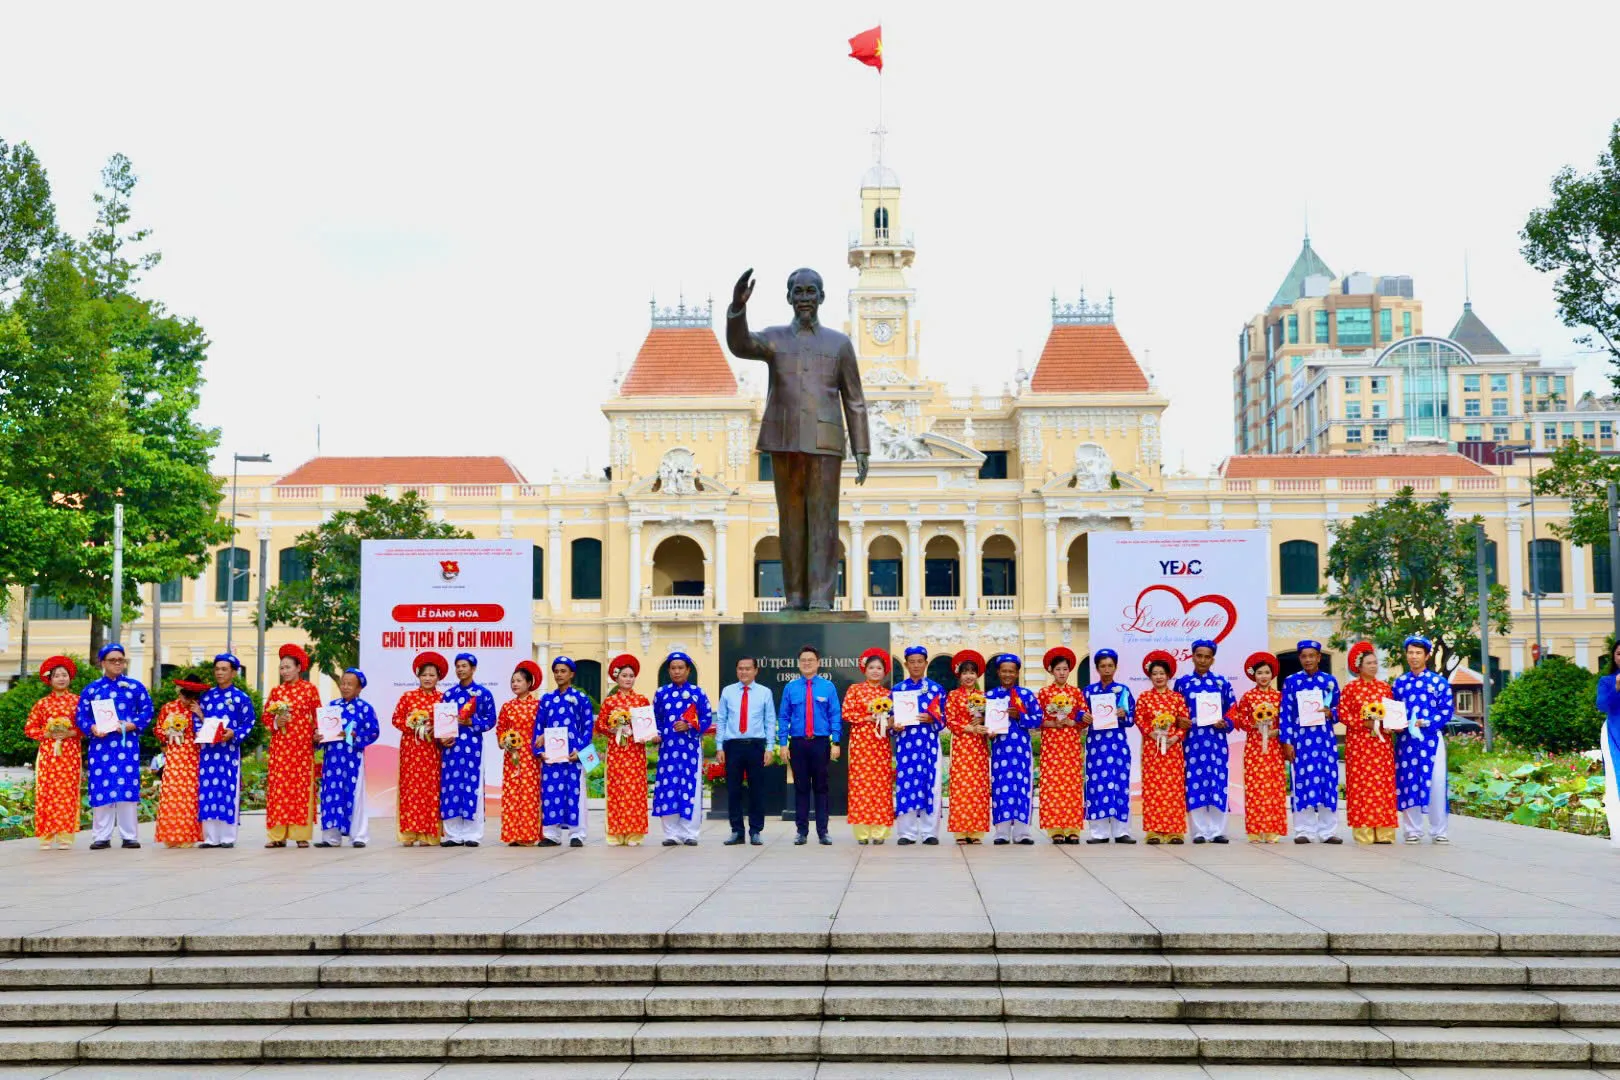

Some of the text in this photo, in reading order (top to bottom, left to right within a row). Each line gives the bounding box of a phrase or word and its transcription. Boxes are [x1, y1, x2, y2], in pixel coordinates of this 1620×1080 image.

[429, 608, 456, 618] DÂNG
[458, 610, 478, 618] HOA
[382, 626, 513, 652] CHỦ TỊCH HỒ CHÍ MINH
[770, 658, 794, 670] TỊCH
[820, 656, 832, 668] HÍ
